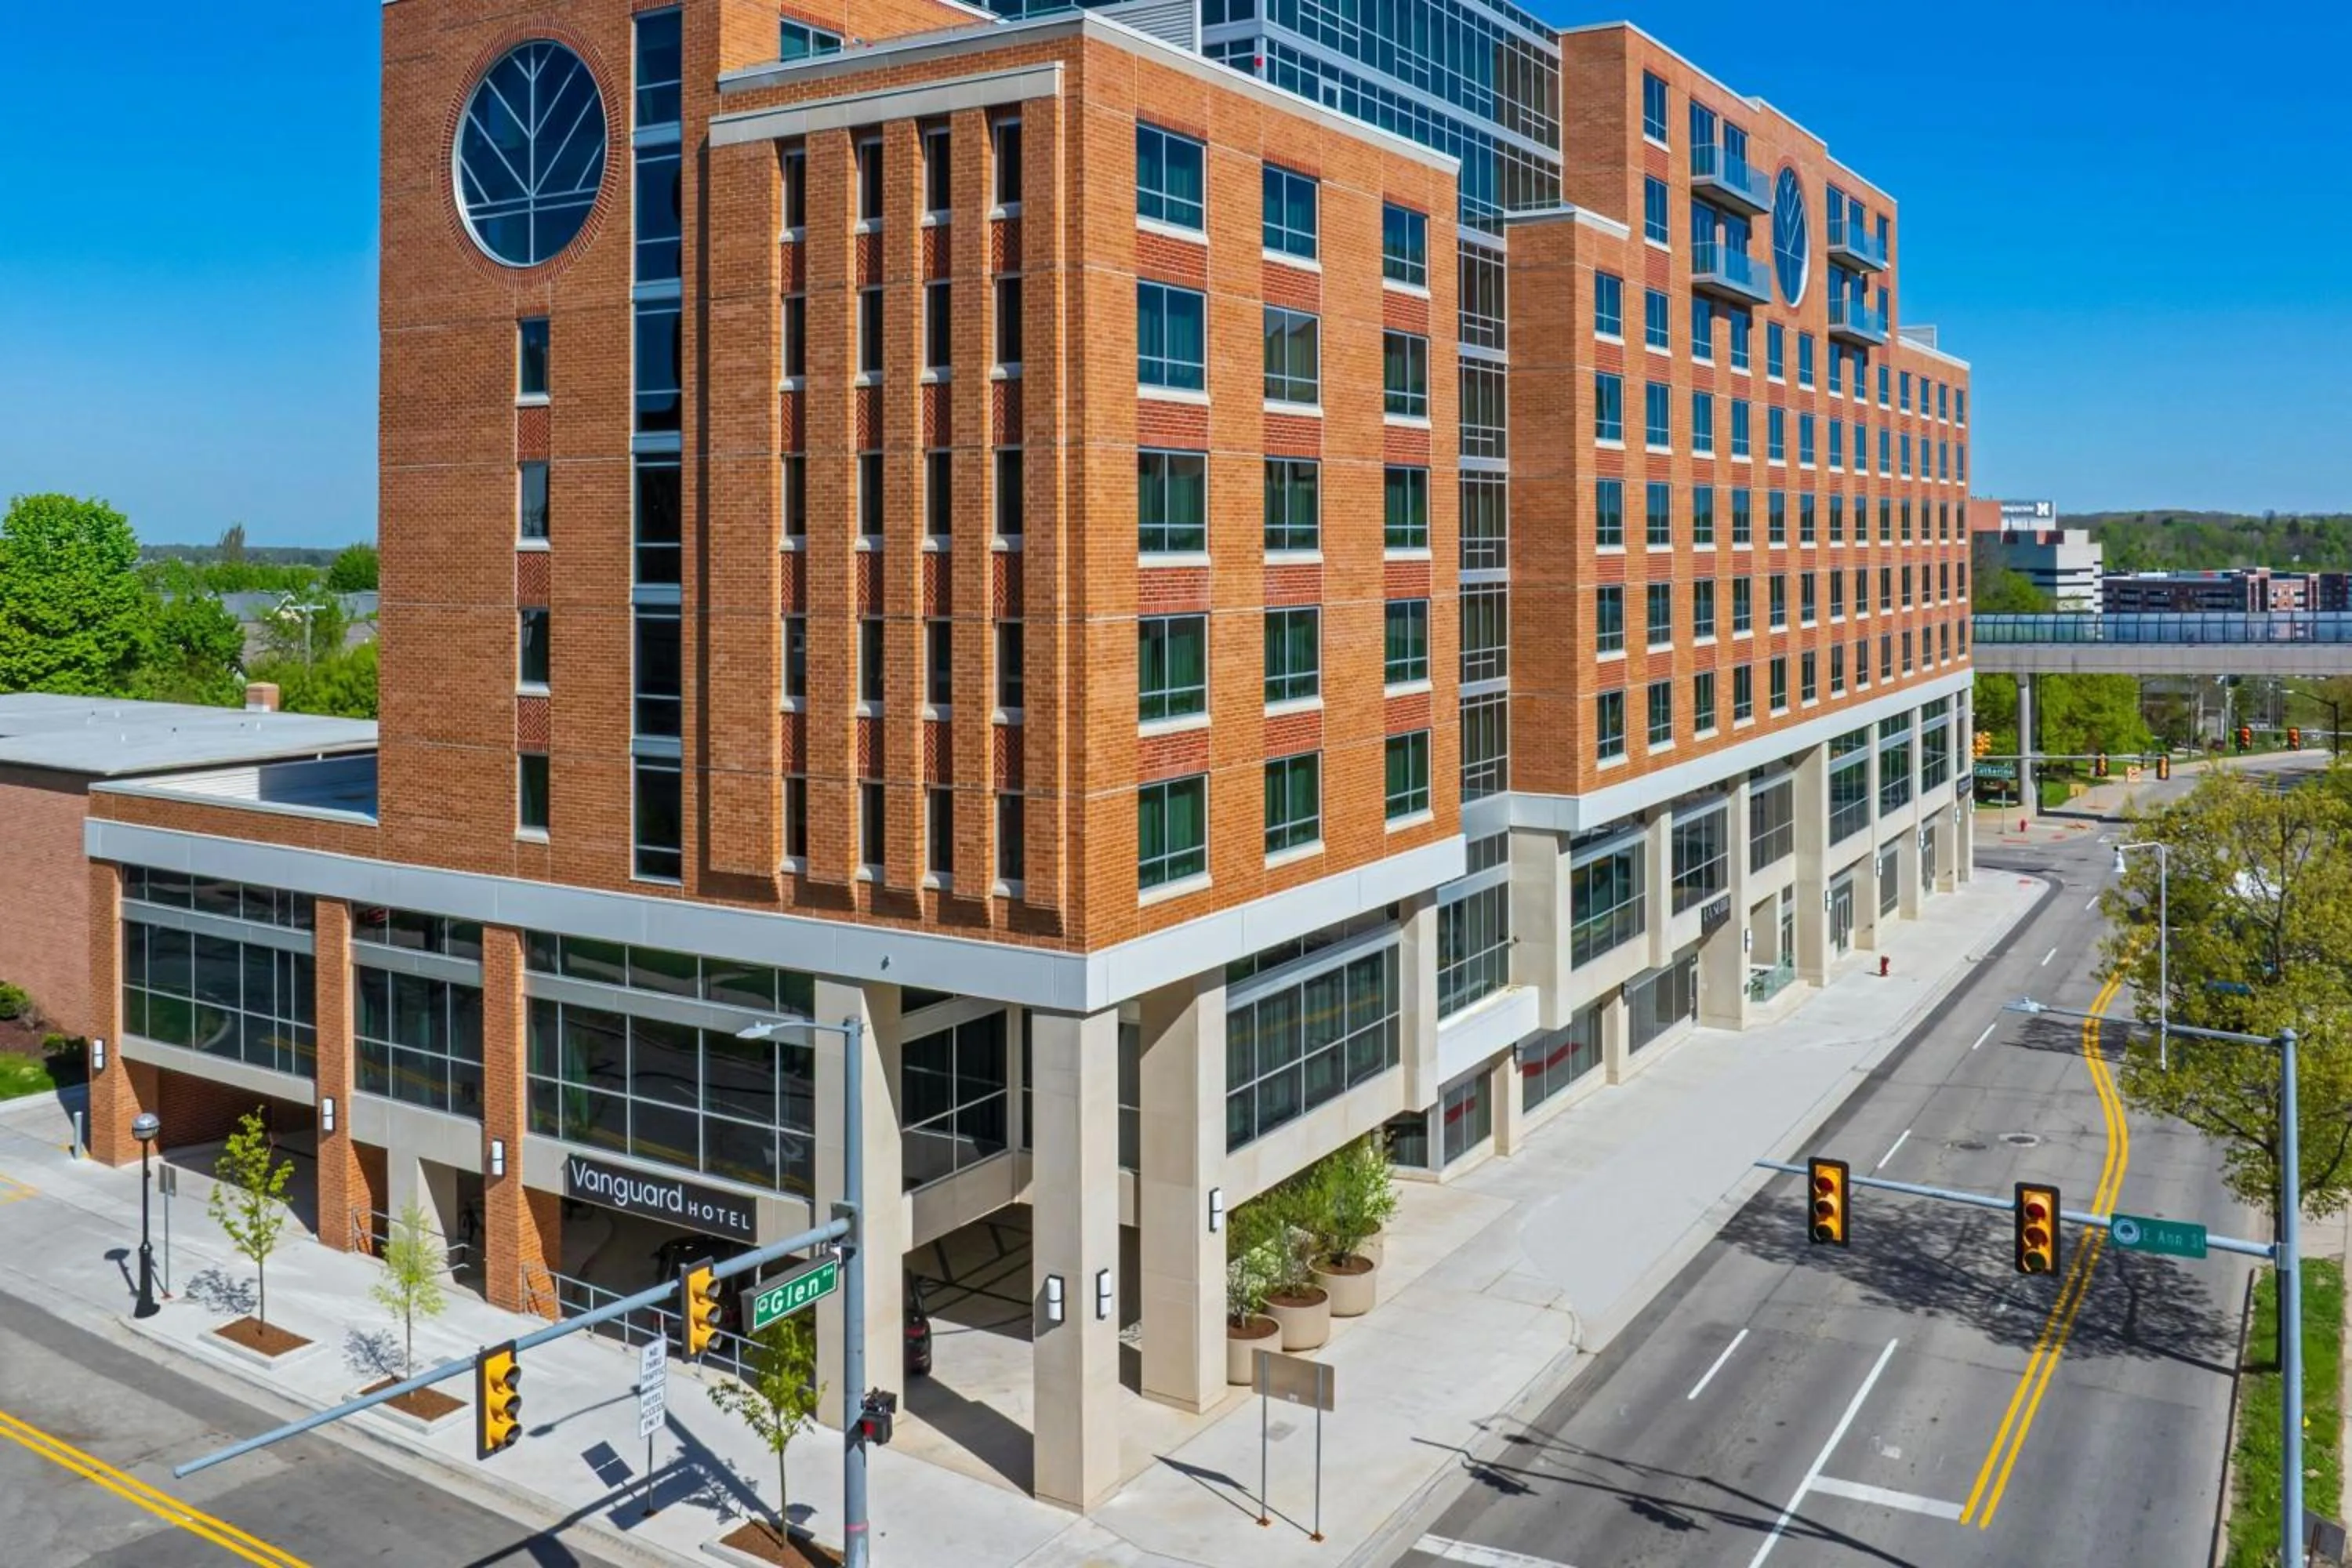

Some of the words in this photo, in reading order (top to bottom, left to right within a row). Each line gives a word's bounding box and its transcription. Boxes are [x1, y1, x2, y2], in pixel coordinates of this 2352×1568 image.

[570, 1160, 684, 1212] Vanguard
[688, 1200, 750, 1230] HOTEL
[2143, 1227, 2150, 1241] E
[2158, 1229, 2183, 1247] Ann
[771, 1277, 819, 1313] Glen
[643, 1392, 662, 1408] HOTEL
[644, 1414, 661, 1430] ONLY
